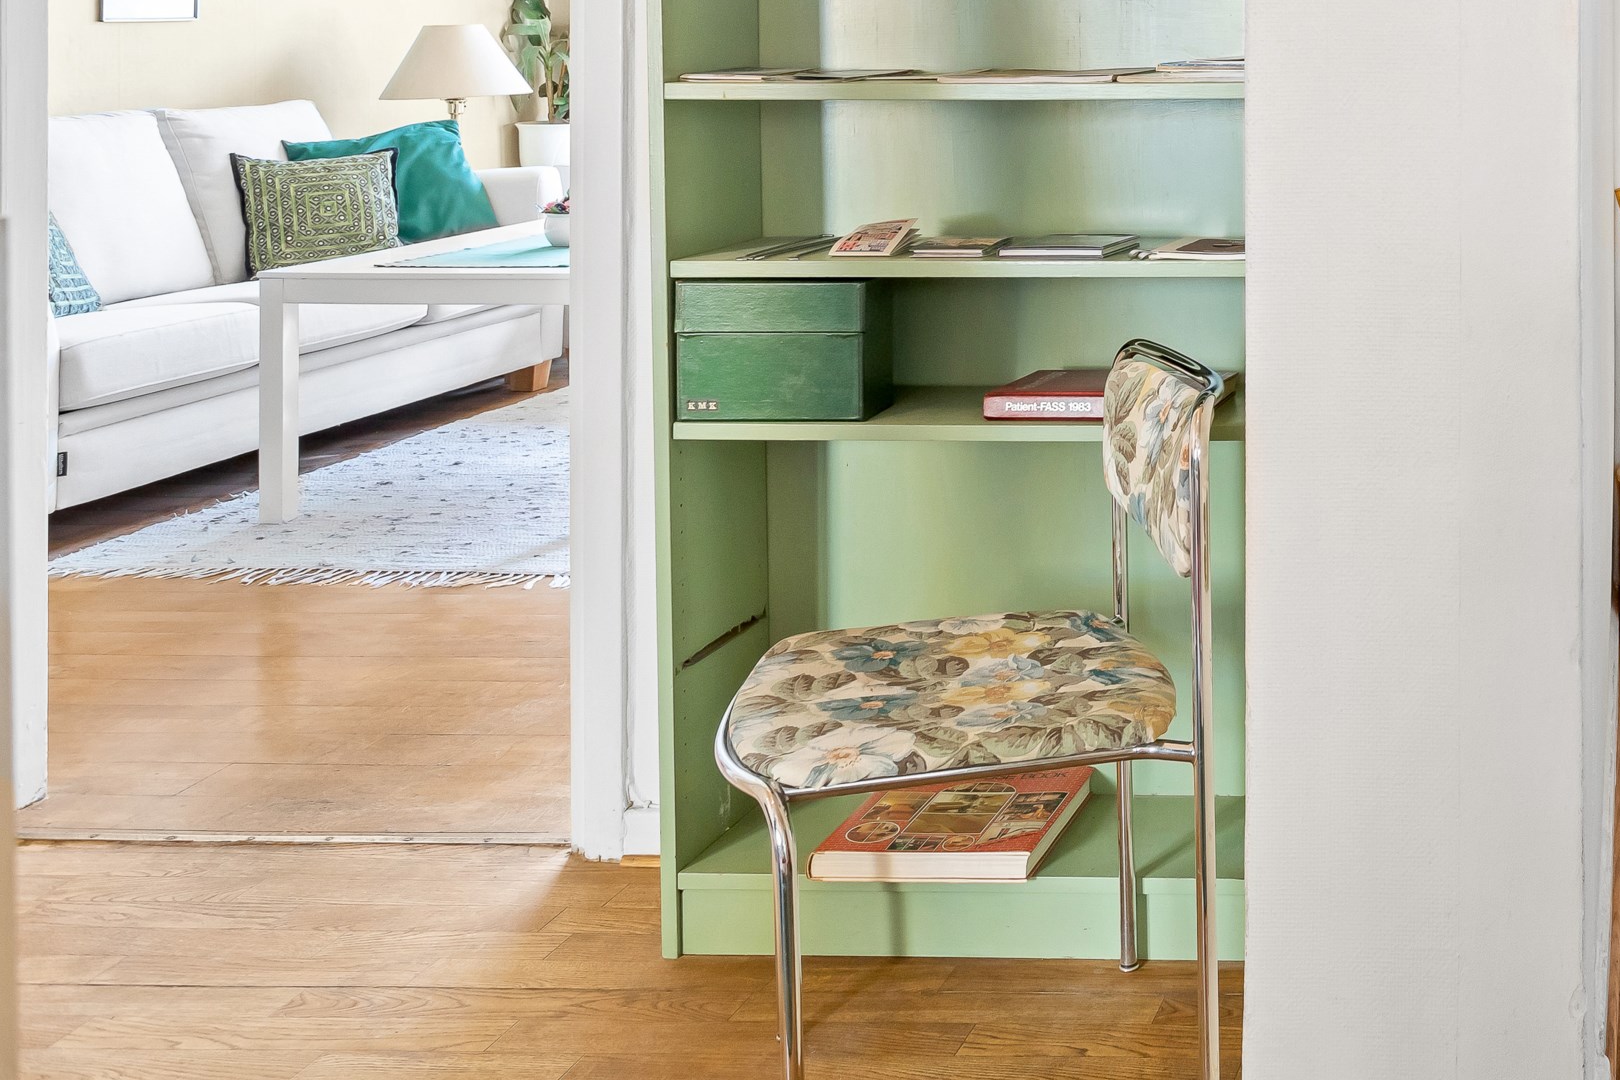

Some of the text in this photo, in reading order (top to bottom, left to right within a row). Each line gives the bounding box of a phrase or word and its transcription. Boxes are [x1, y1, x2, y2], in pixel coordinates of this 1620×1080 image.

[1005, 402, 1091, 412] Patient-FASS 1983
[1020, 771, 1069, 780] BOOK
